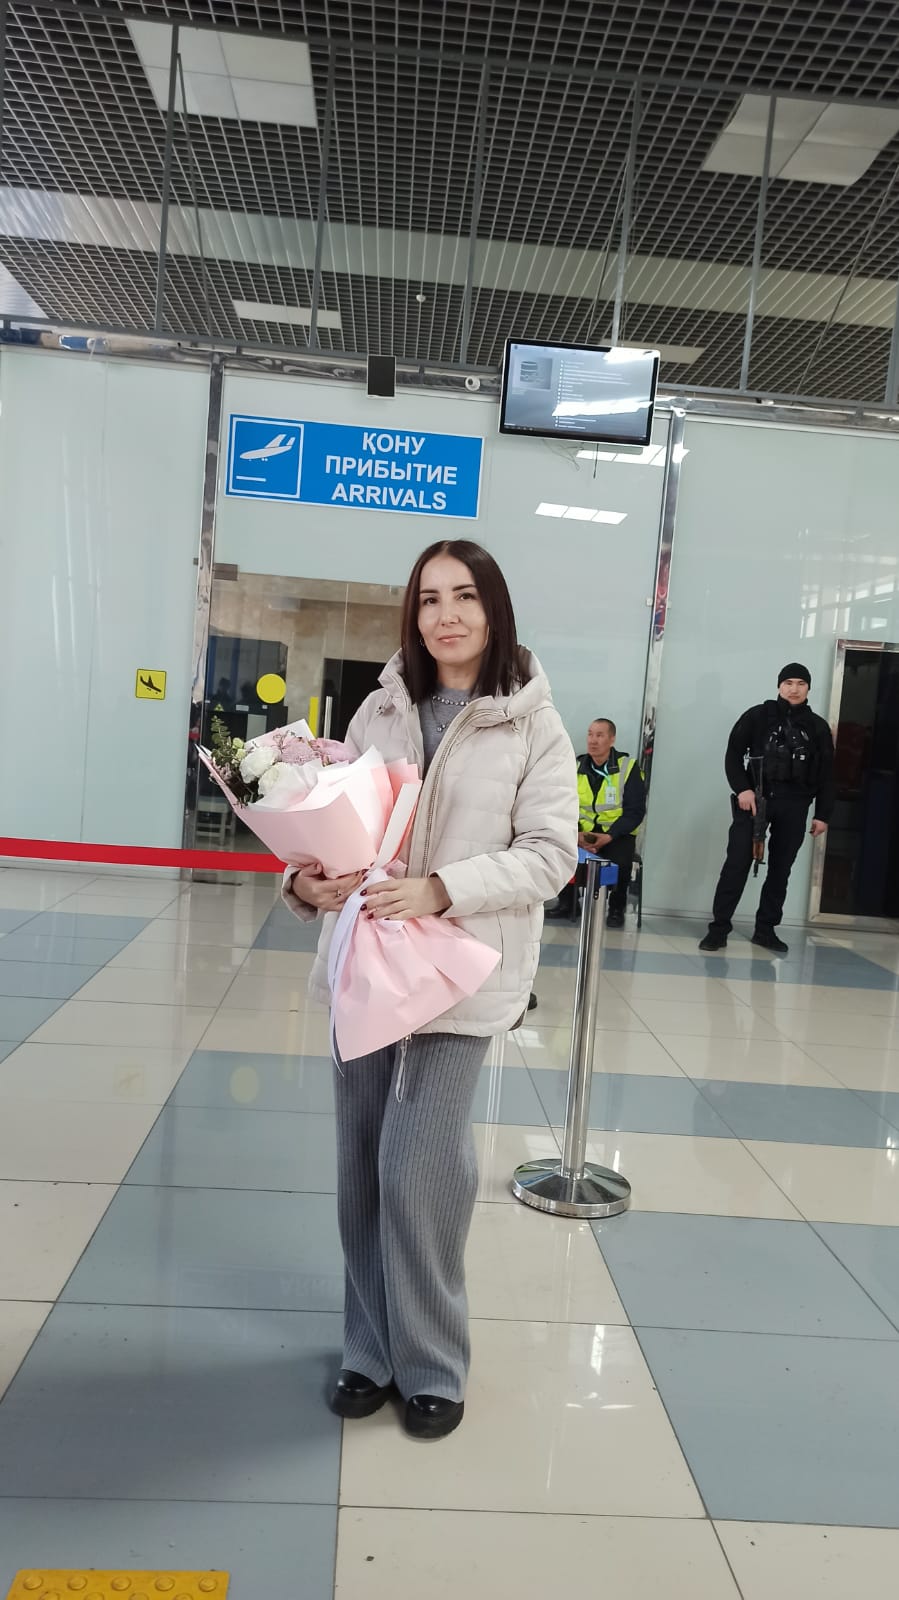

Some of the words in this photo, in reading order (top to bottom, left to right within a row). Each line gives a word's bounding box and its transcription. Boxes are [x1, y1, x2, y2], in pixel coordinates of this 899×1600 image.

[362, 432, 425, 455] ҚОНУ
[325, 456, 458, 485] ПРИБЫТИЕ
[331, 482, 447, 511] ARRIVALS
